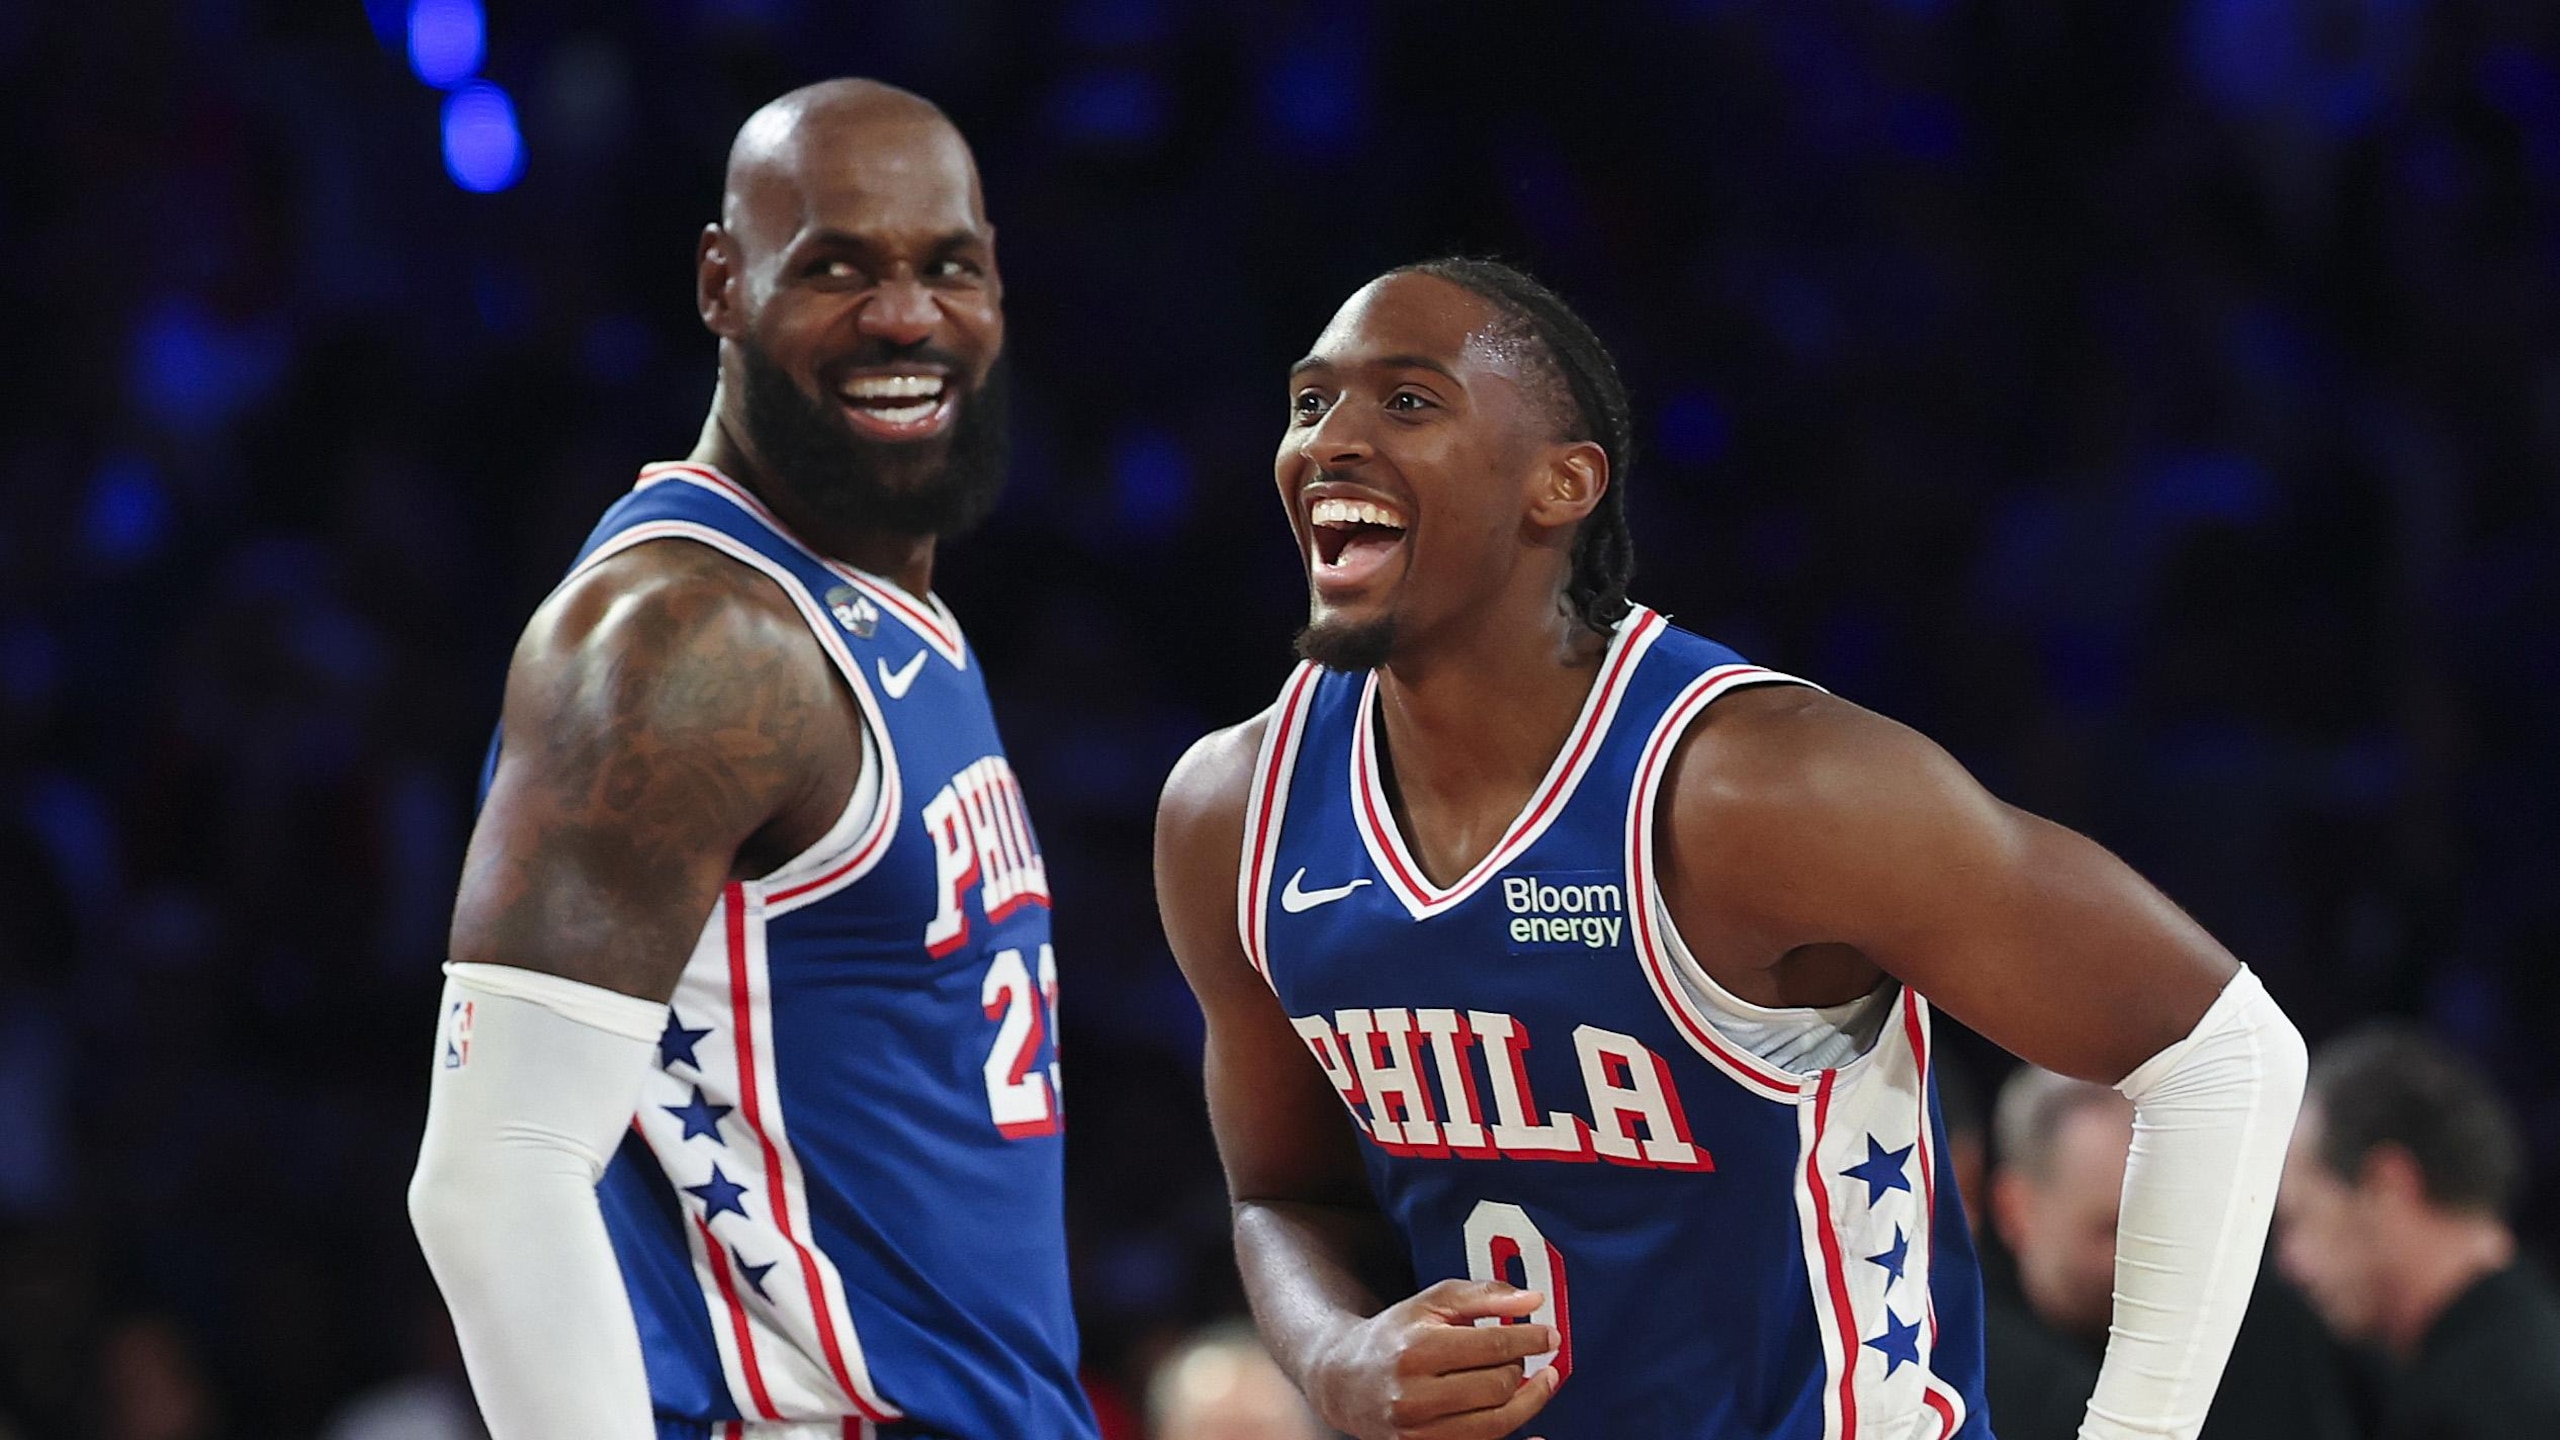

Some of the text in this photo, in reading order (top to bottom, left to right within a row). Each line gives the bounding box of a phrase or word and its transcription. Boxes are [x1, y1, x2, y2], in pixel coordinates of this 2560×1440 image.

[1503, 877, 1621, 913] Bloom
[1510, 917, 1622, 948] energy
[1289, 1008, 1715, 1171] PHILA
